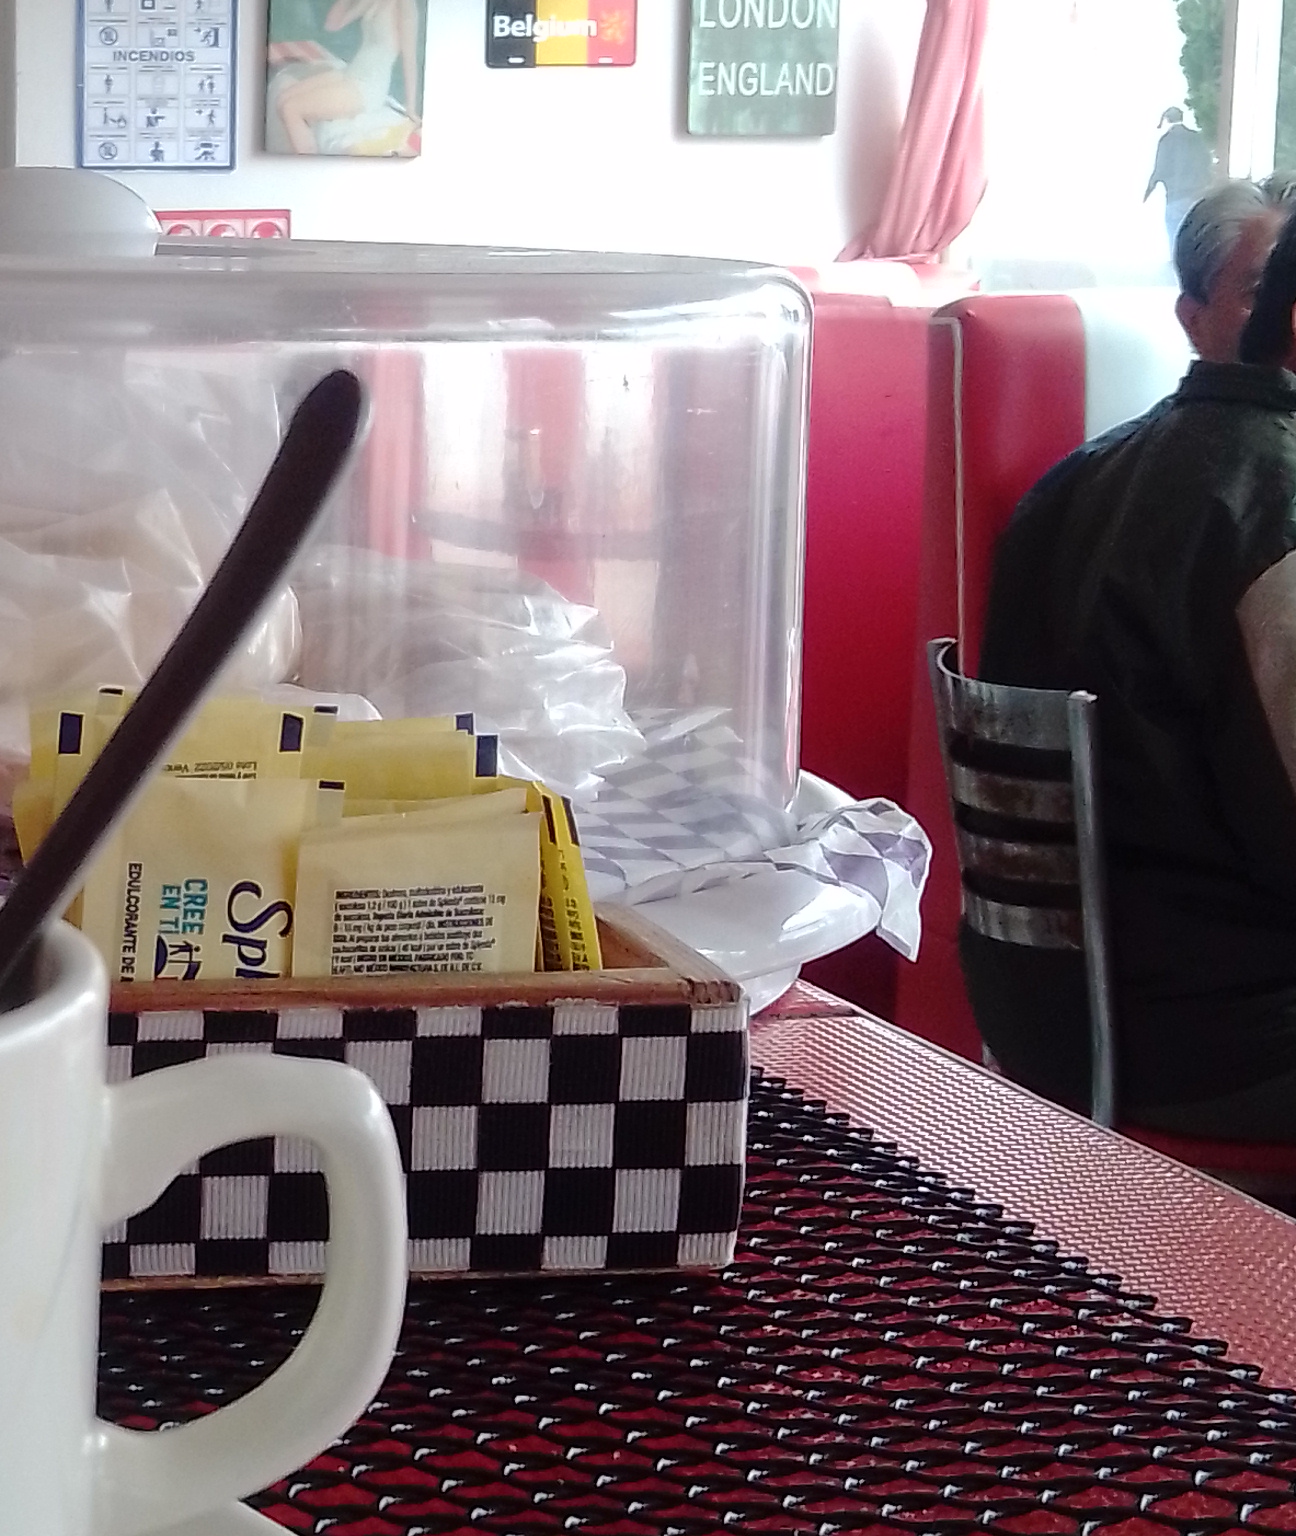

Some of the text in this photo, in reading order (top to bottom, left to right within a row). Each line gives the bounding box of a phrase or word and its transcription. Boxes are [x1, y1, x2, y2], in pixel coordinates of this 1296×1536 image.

[492, 13, 598, 43] Belgium
[112, 50, 196, 63] INCENDIOS
[698, 62, 835, 96] ENGLAND
[122, 863, 143, 953] EDULCORANTE
[160, 884, 182, 910] EN
[182, 878, 208, 935] CREE
[221, 880, 294, 979] Spl
[120, 956, 136, 975] DE
